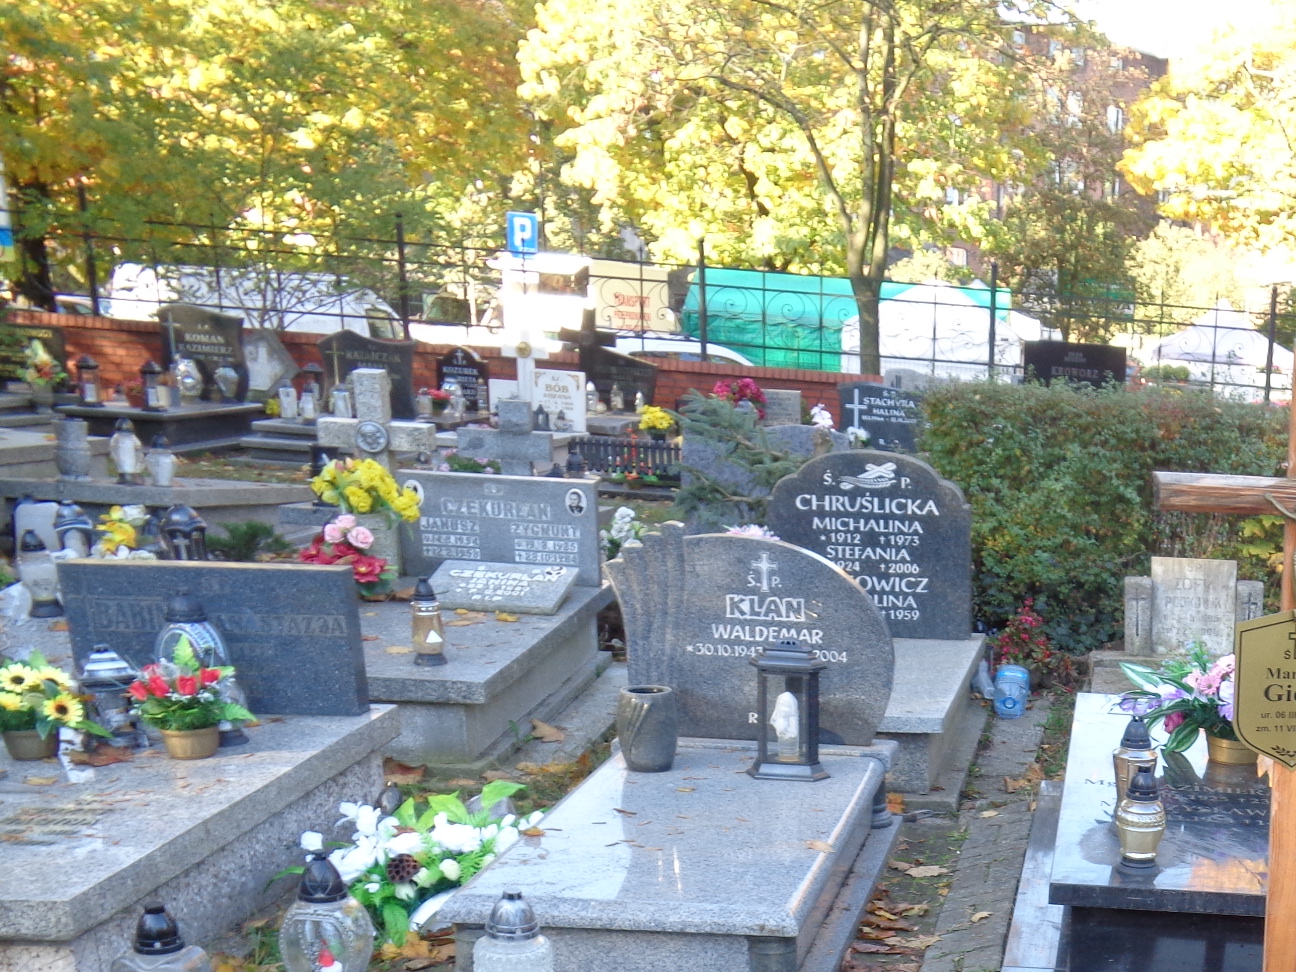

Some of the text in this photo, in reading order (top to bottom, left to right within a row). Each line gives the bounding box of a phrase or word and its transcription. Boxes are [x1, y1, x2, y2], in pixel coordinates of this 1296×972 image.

[513, 216, 533, 247] P
[873, 407, 906, 417] HALINA
[795, 491, 940, 516] CHRUŚLICKA
[421, 517, 480, 533] JANUSZ
[510, 522, 580, 538] ZYGMUNT
[812, 516, 924, 534] MICHALINA
[826, 545, 911, 561] STEFANIA
[852, 575, 930, 593] OWICZ
[725, 593, 806, 622] KLAN
[711, 623, 824, 645] WALDEMAR
[1260, 711, 1273, 719] ur.
